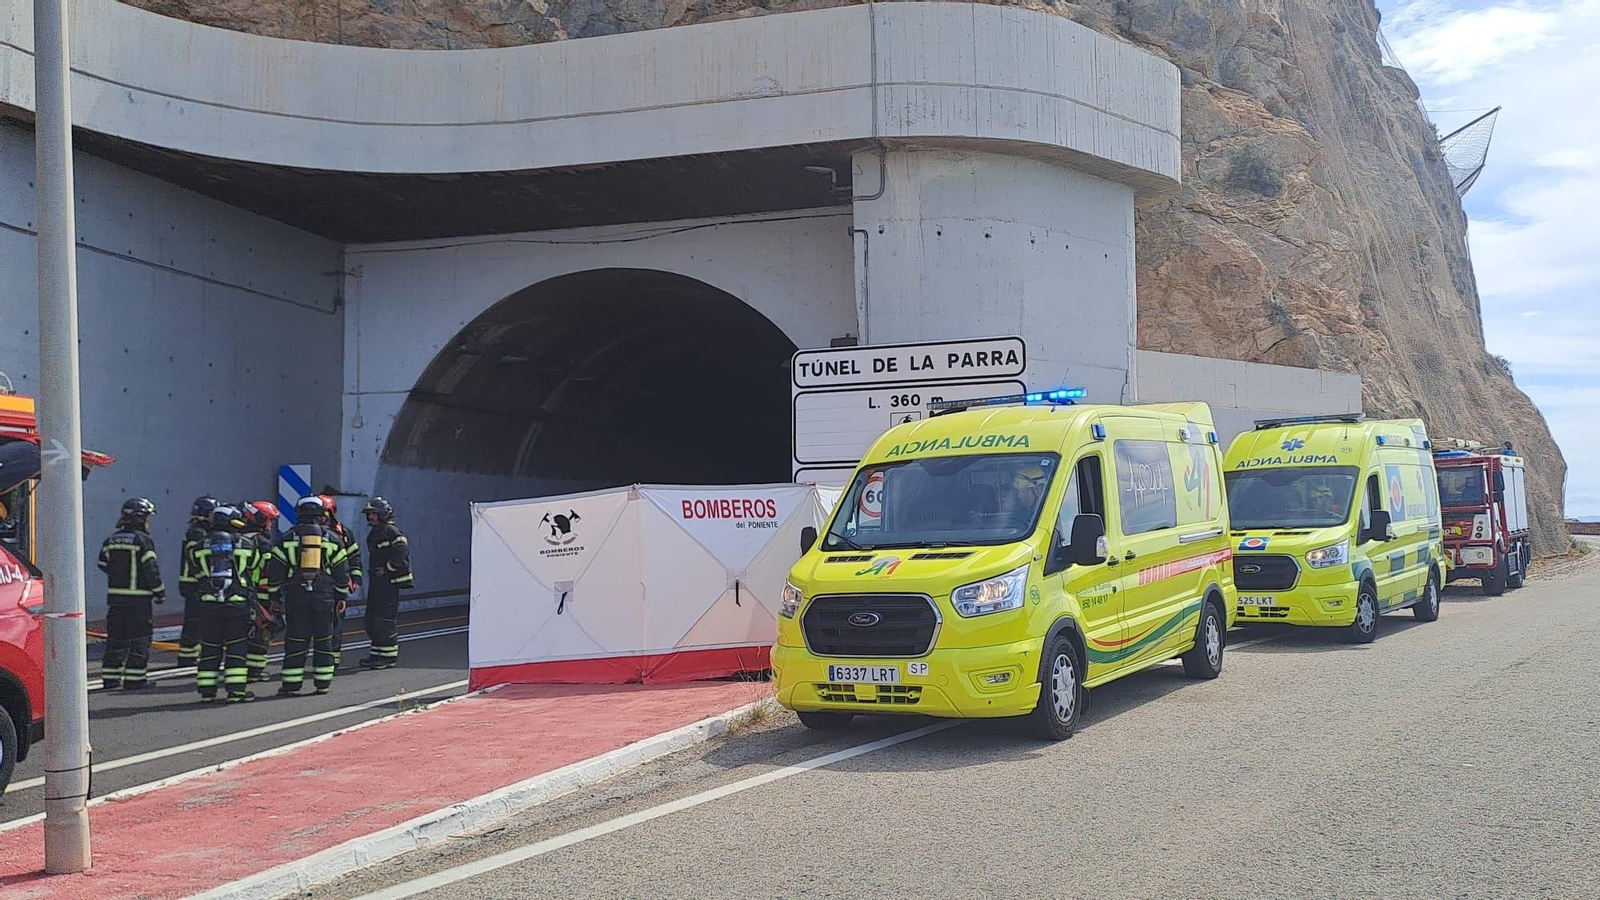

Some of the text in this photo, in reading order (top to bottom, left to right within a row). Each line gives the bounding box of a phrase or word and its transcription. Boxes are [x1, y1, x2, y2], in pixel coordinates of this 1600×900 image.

[798, 350, 1019, 378] TÚNEL DE LA PARRA
[868, 397, 881, 409] L.
[890, 394, 921, 407] 360
[681, 499, 777, 519] BOMBEROS
[735, 521, 779, 529] del PONIENTE
[539, 546, 585, 555] BOMBEROS
[1256, 596, 1273, 605] LKT
[836, 667, 896, 681] 6337 LRT
[910, 663, 928, 674] SP
